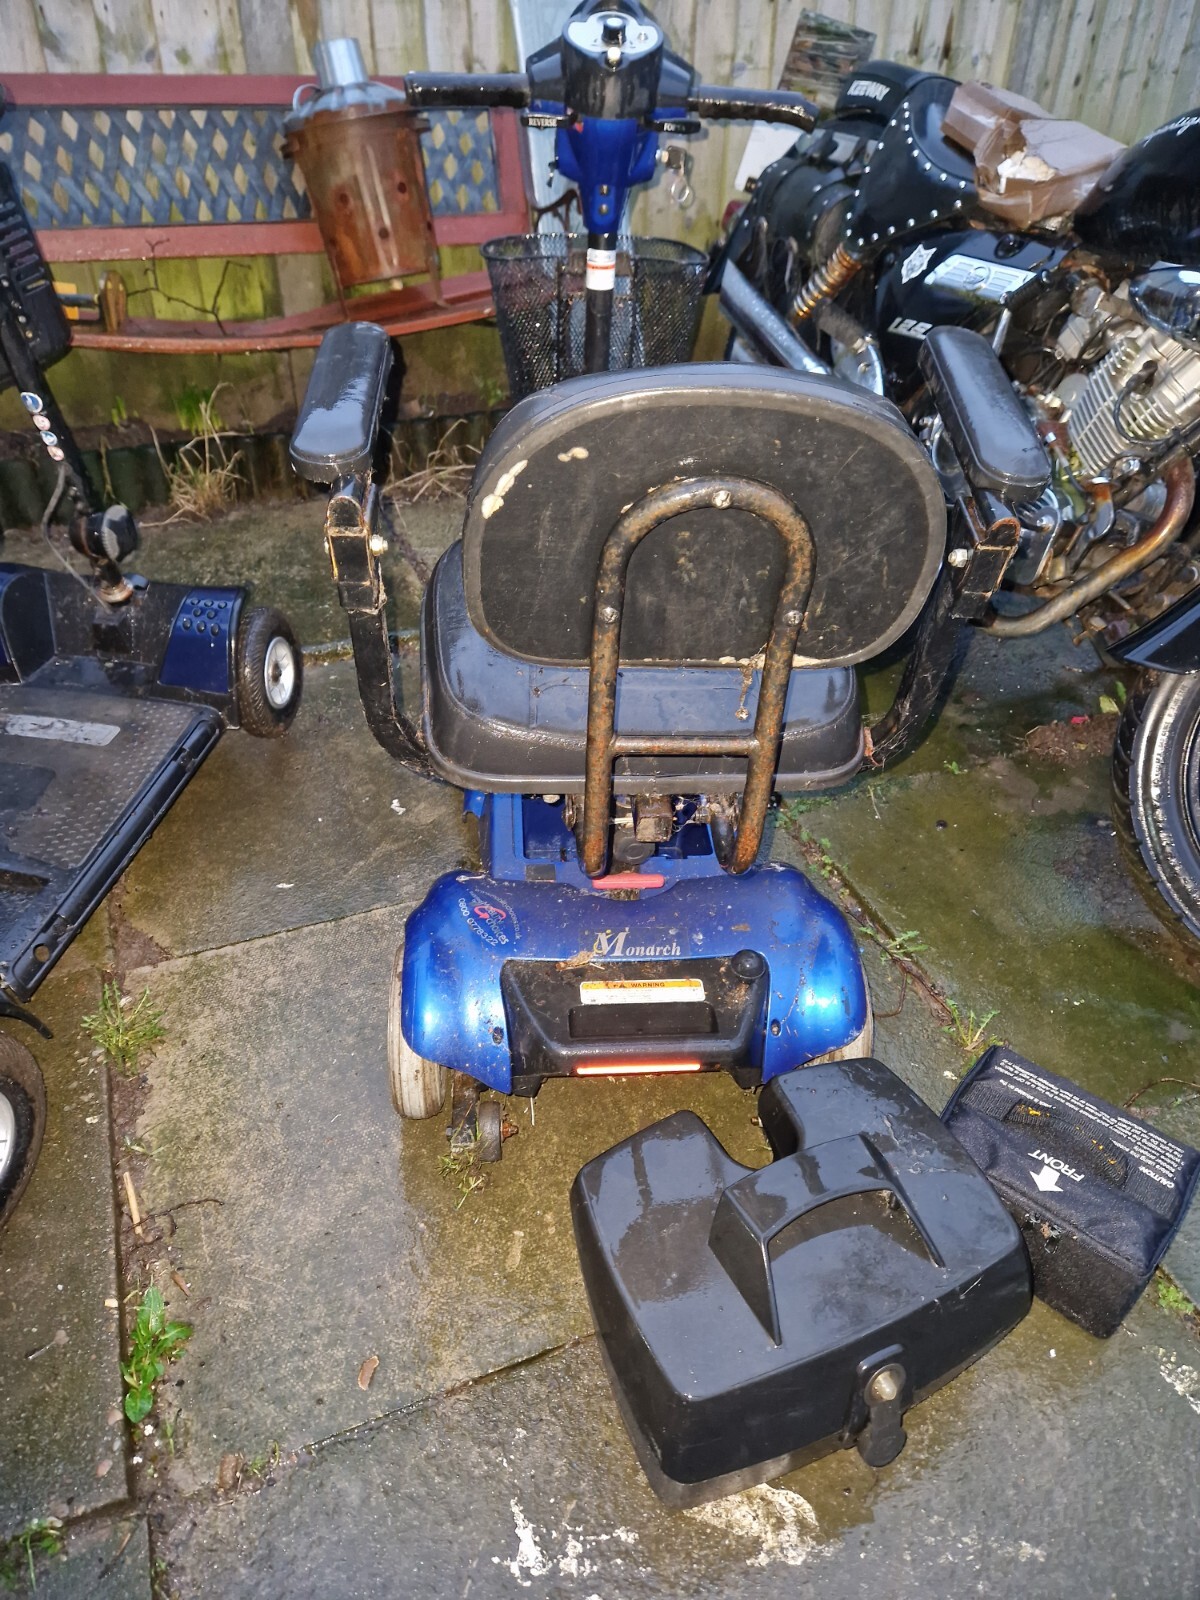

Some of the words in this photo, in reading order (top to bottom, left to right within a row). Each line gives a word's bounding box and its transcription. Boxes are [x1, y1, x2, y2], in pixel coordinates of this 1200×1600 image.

[528, 117, 557, 127] REVERSE
[458, 897, 470, 917] 0800
[466, 917, 499, 947] 0778322
[594, 930, 681, 957] Monarch
[631, 981, 666, 989] WARNING
[1028, 1149, 1085, 1182] FRONT
